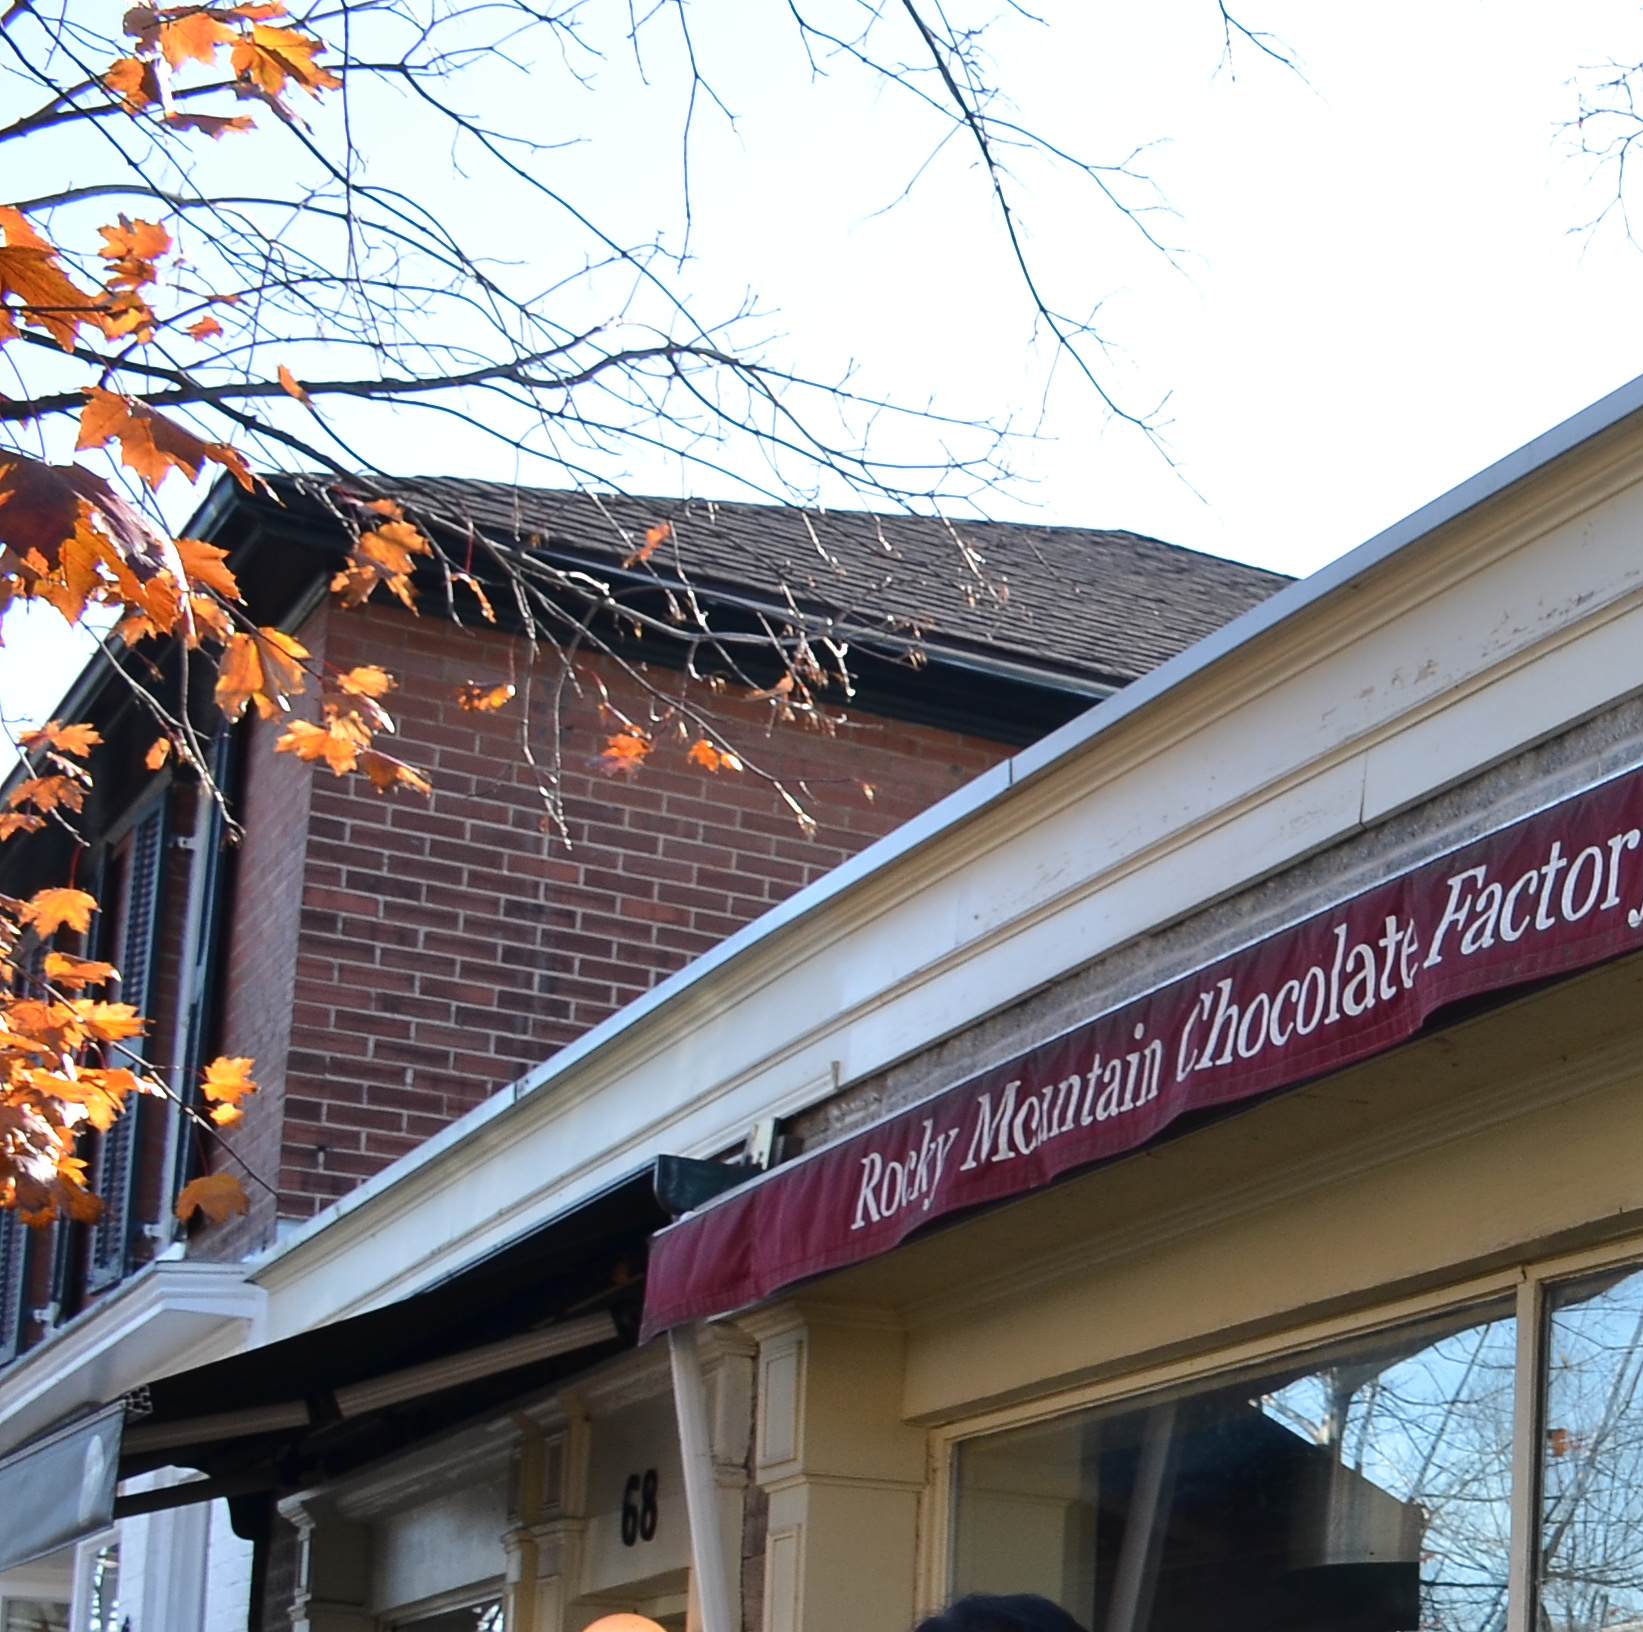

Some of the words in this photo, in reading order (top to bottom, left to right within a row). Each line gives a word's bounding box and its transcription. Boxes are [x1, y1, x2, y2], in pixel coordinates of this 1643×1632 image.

[851, 1118, 960, 1230] Rocky
[1175, 914, 1419, 1084] Chocolate
[621, 1468, 659, 1548] 68
